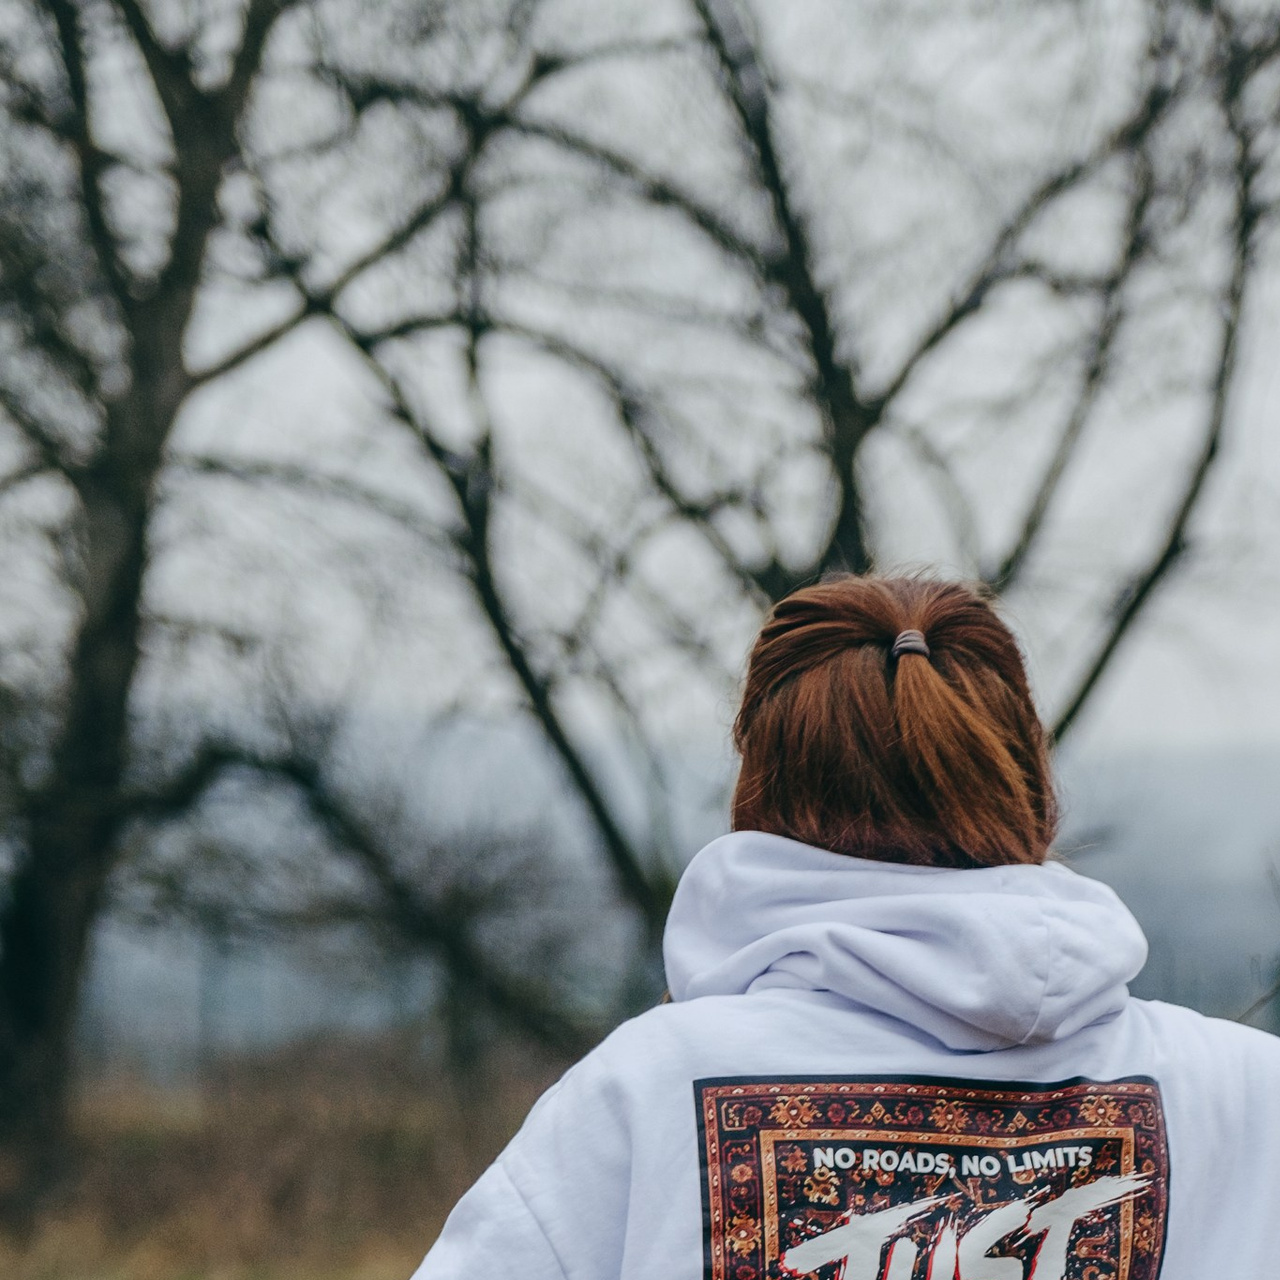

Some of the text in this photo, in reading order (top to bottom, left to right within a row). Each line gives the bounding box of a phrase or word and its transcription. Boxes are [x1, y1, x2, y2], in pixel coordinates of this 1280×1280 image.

[813, 1146, 1093, 1178] NO ROADS, NO LIMITS
